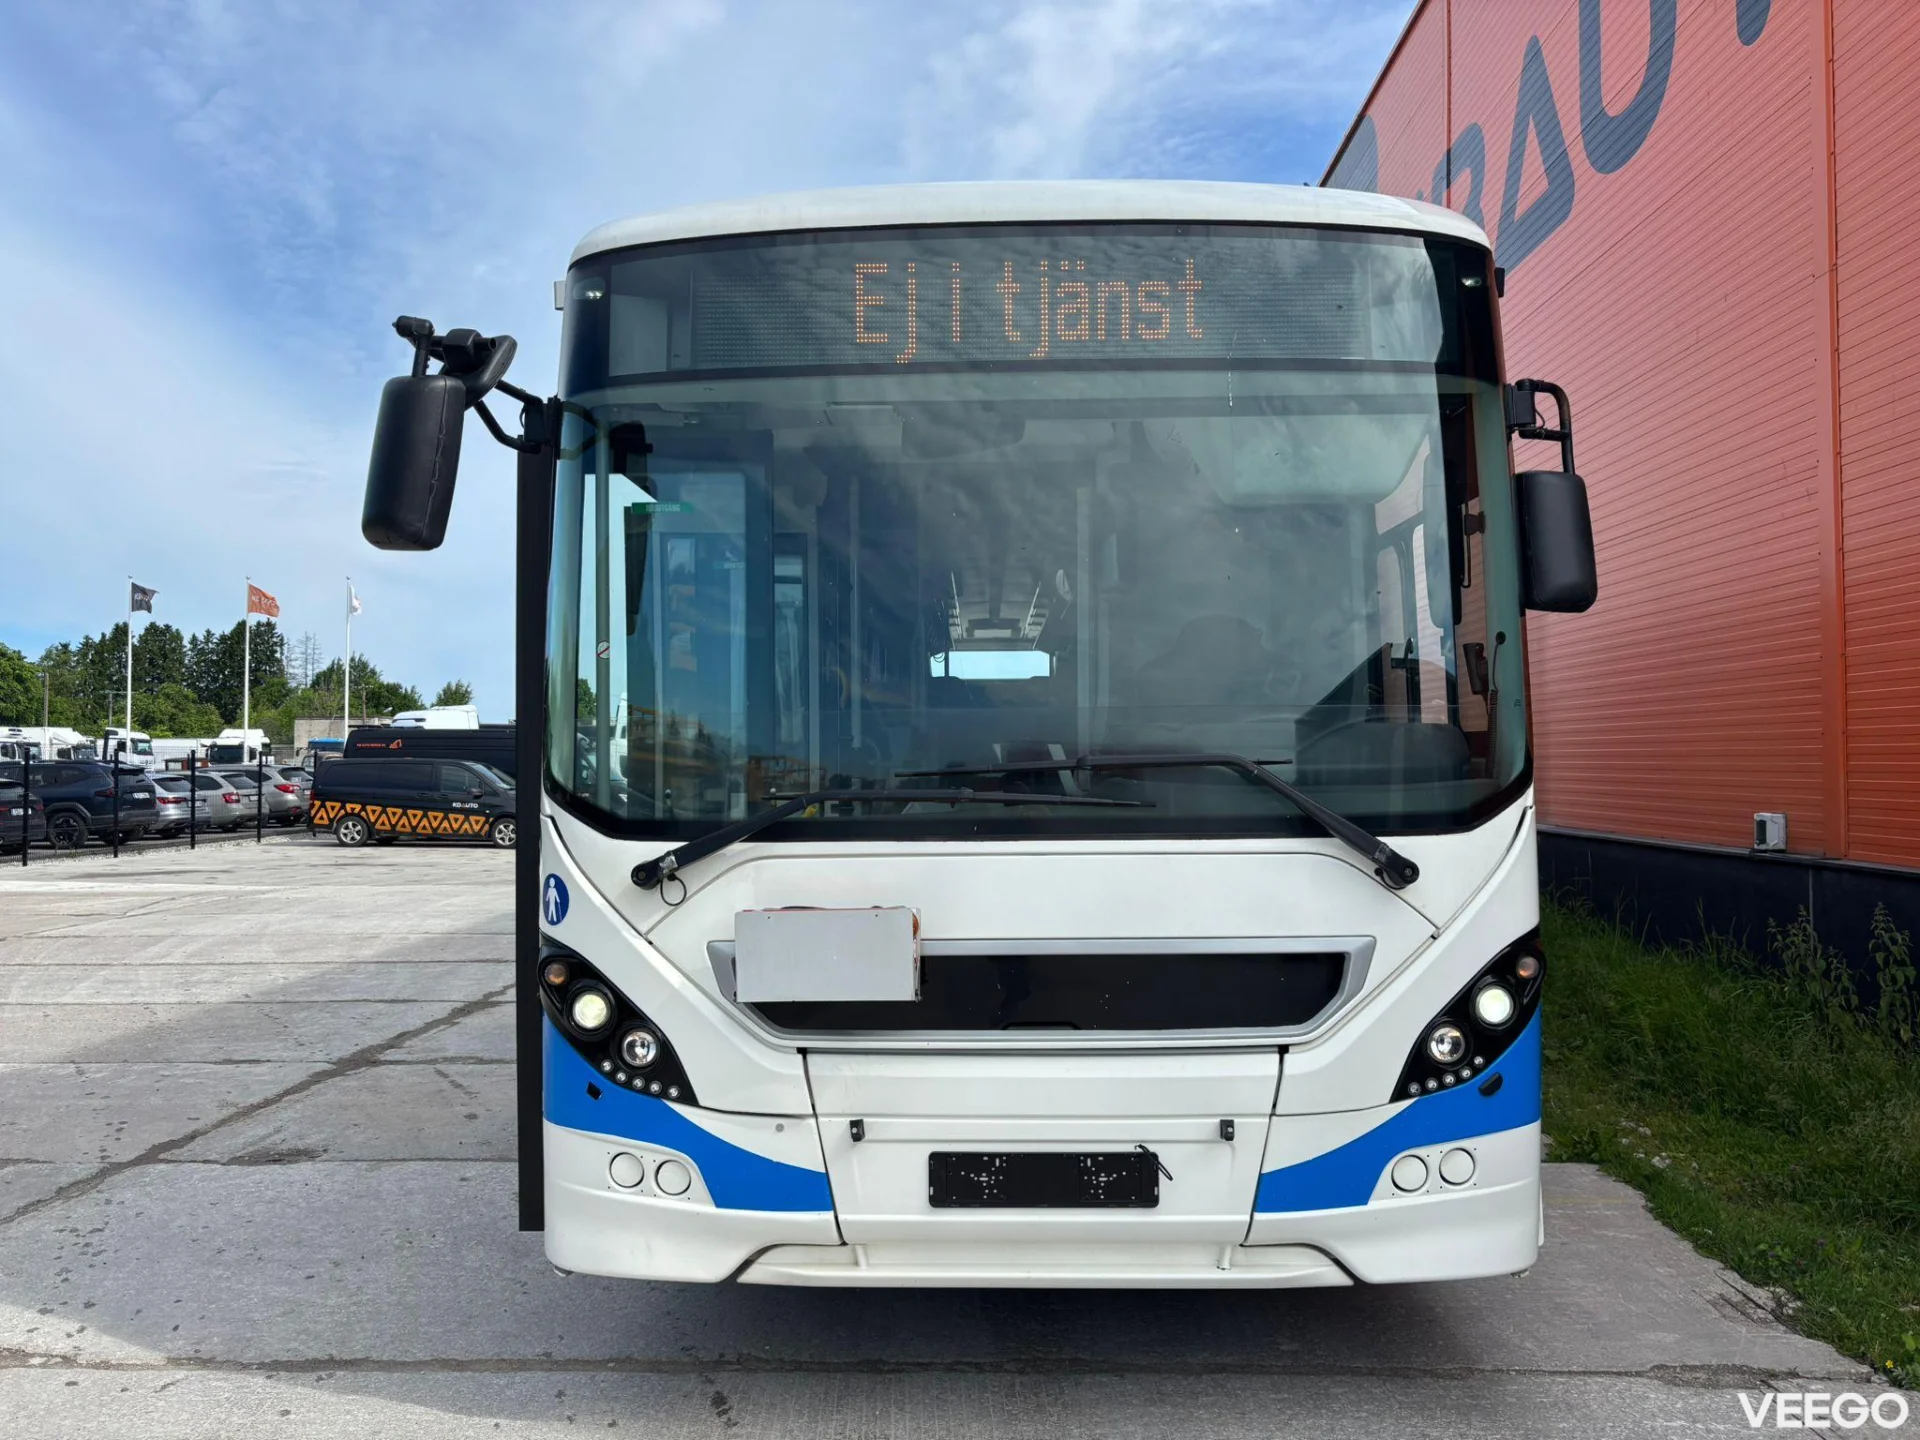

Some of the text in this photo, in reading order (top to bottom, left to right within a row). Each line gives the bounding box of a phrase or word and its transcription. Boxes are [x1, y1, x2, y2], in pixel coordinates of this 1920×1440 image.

[855, 258, 1203, 363] Ej i tjänst
